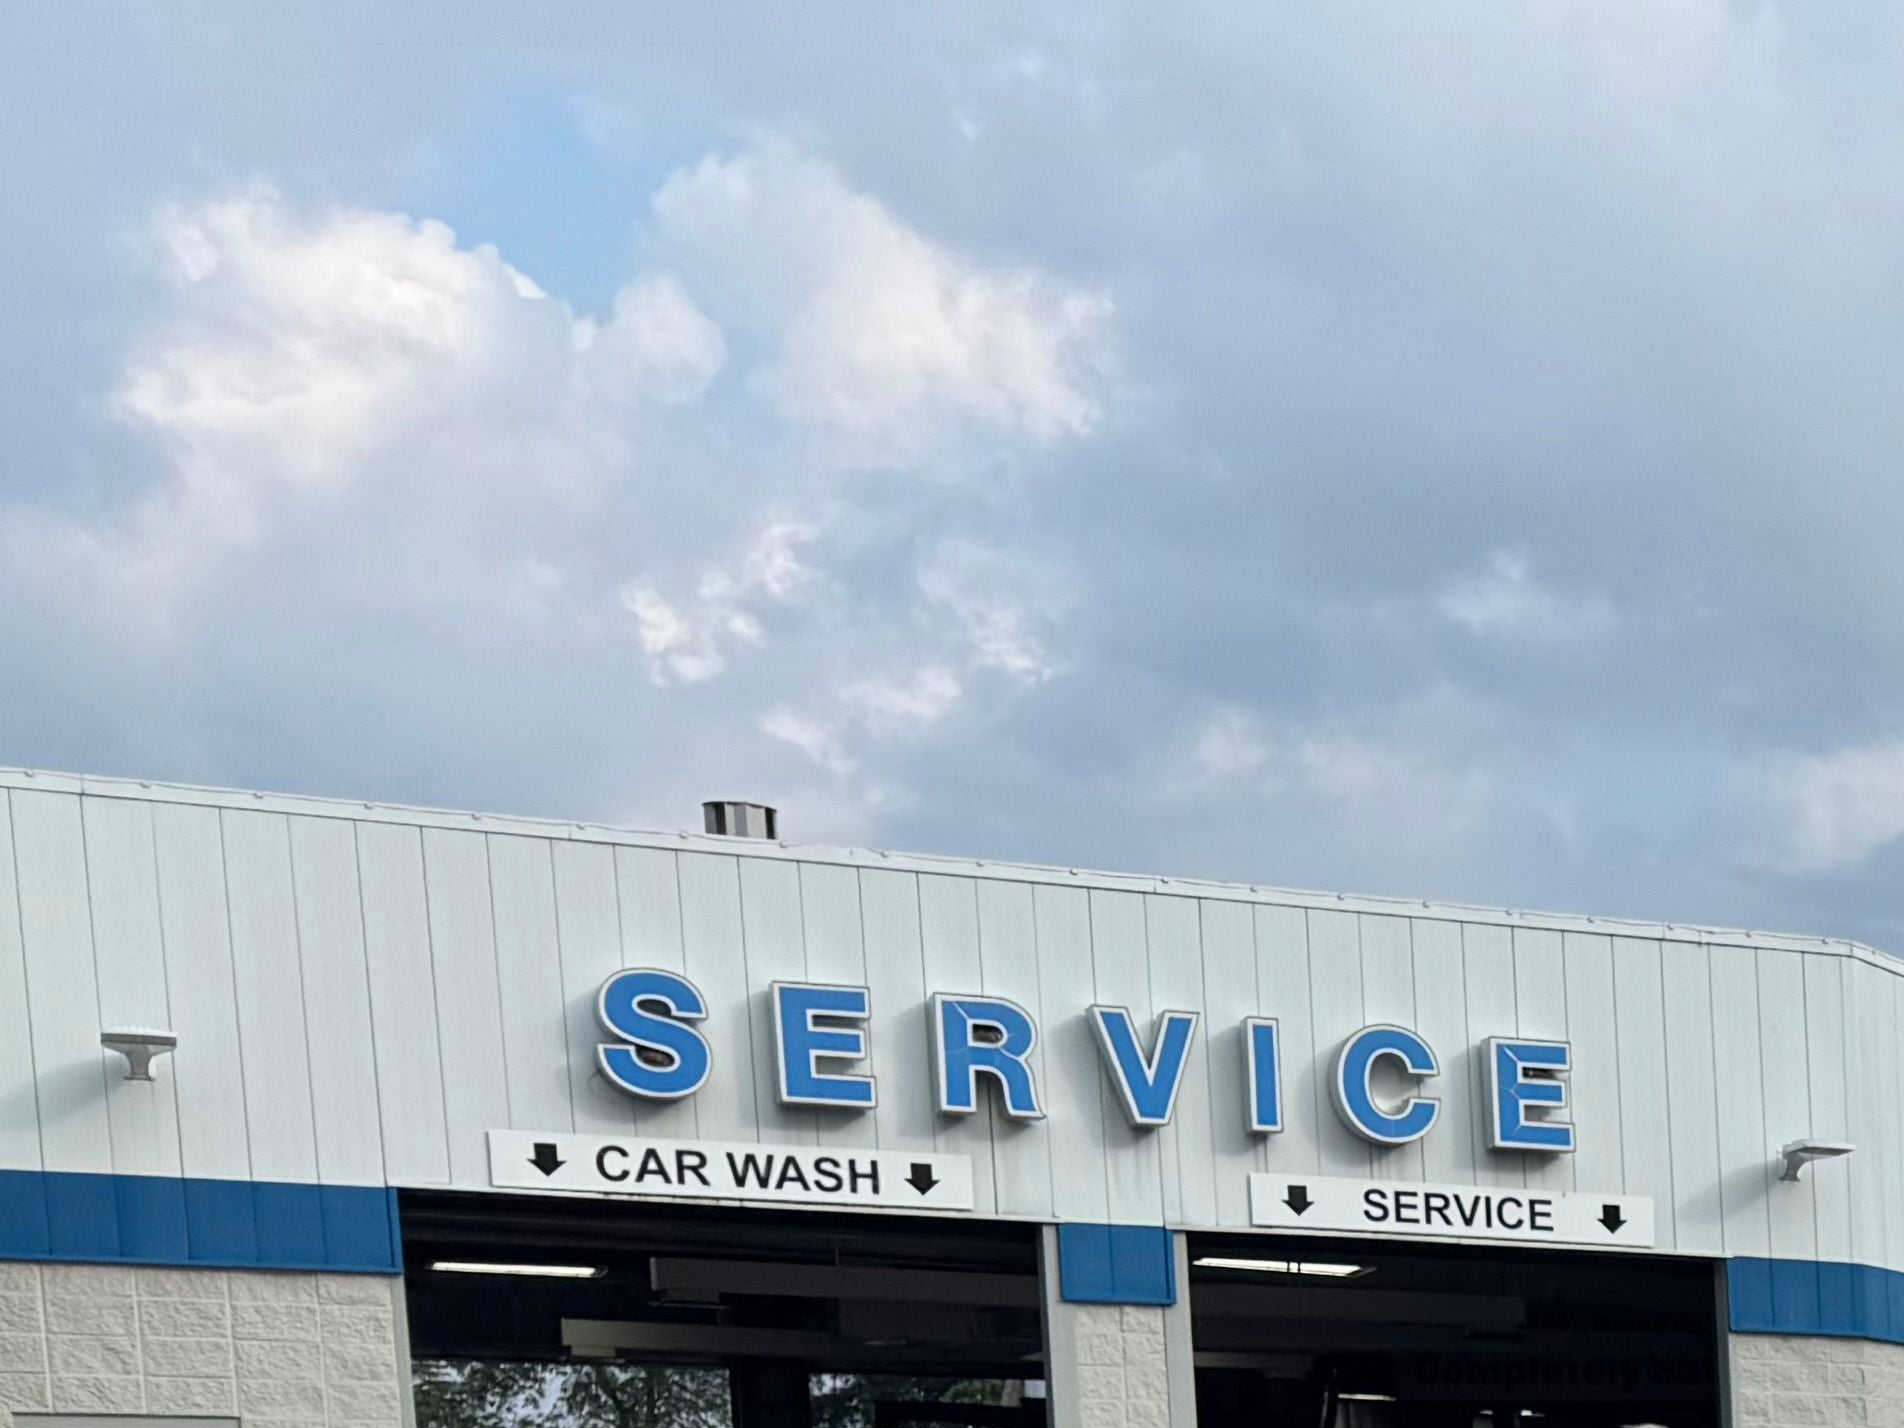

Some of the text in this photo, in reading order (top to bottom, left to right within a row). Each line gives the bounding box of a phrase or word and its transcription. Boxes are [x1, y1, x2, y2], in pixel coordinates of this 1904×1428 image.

[598, 967, 1577, 1152] SERVICE
[596, 1144, 882, 1195] CAR WASH
[1362, 1188, 1555, 1234] SERVICE
